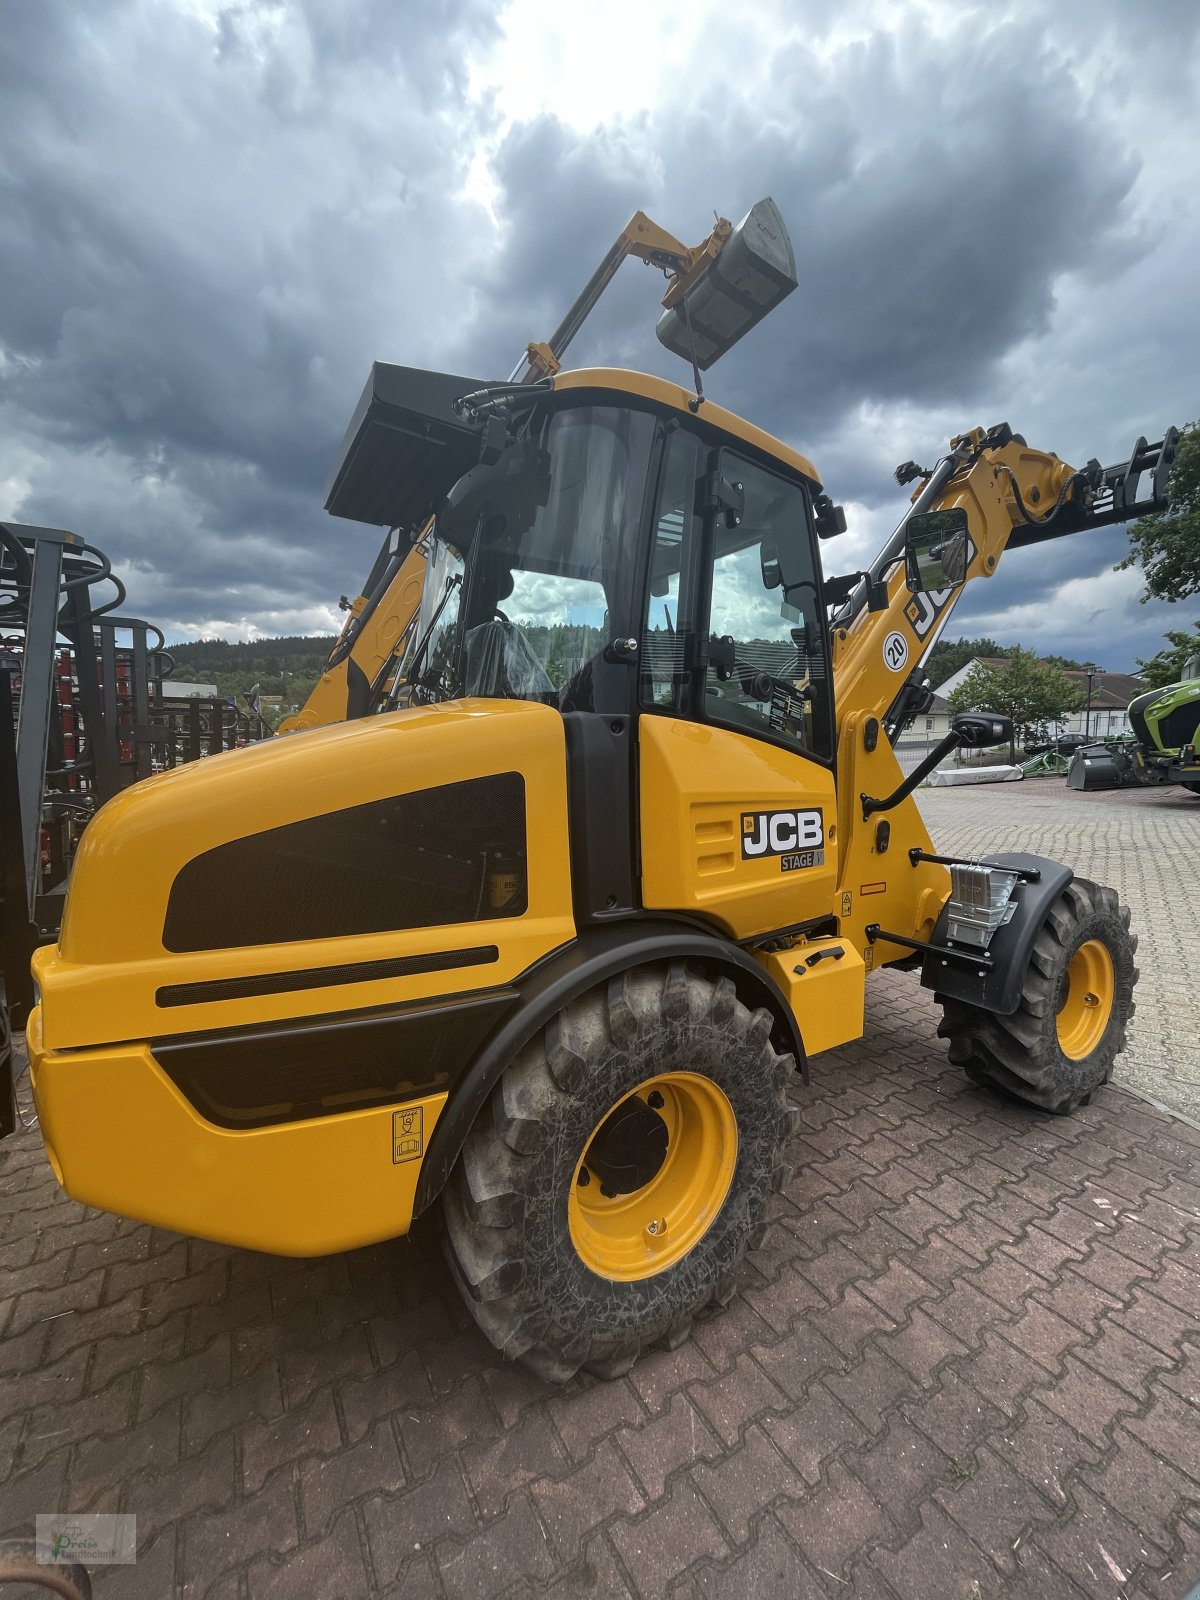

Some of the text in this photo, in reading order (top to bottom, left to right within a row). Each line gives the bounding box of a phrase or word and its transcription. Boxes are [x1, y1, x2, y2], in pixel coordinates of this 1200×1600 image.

[887, 637, 905, 667] 20
[743, 811, 823, 855] JCB
[782, 853, 812, 870] STAGE
